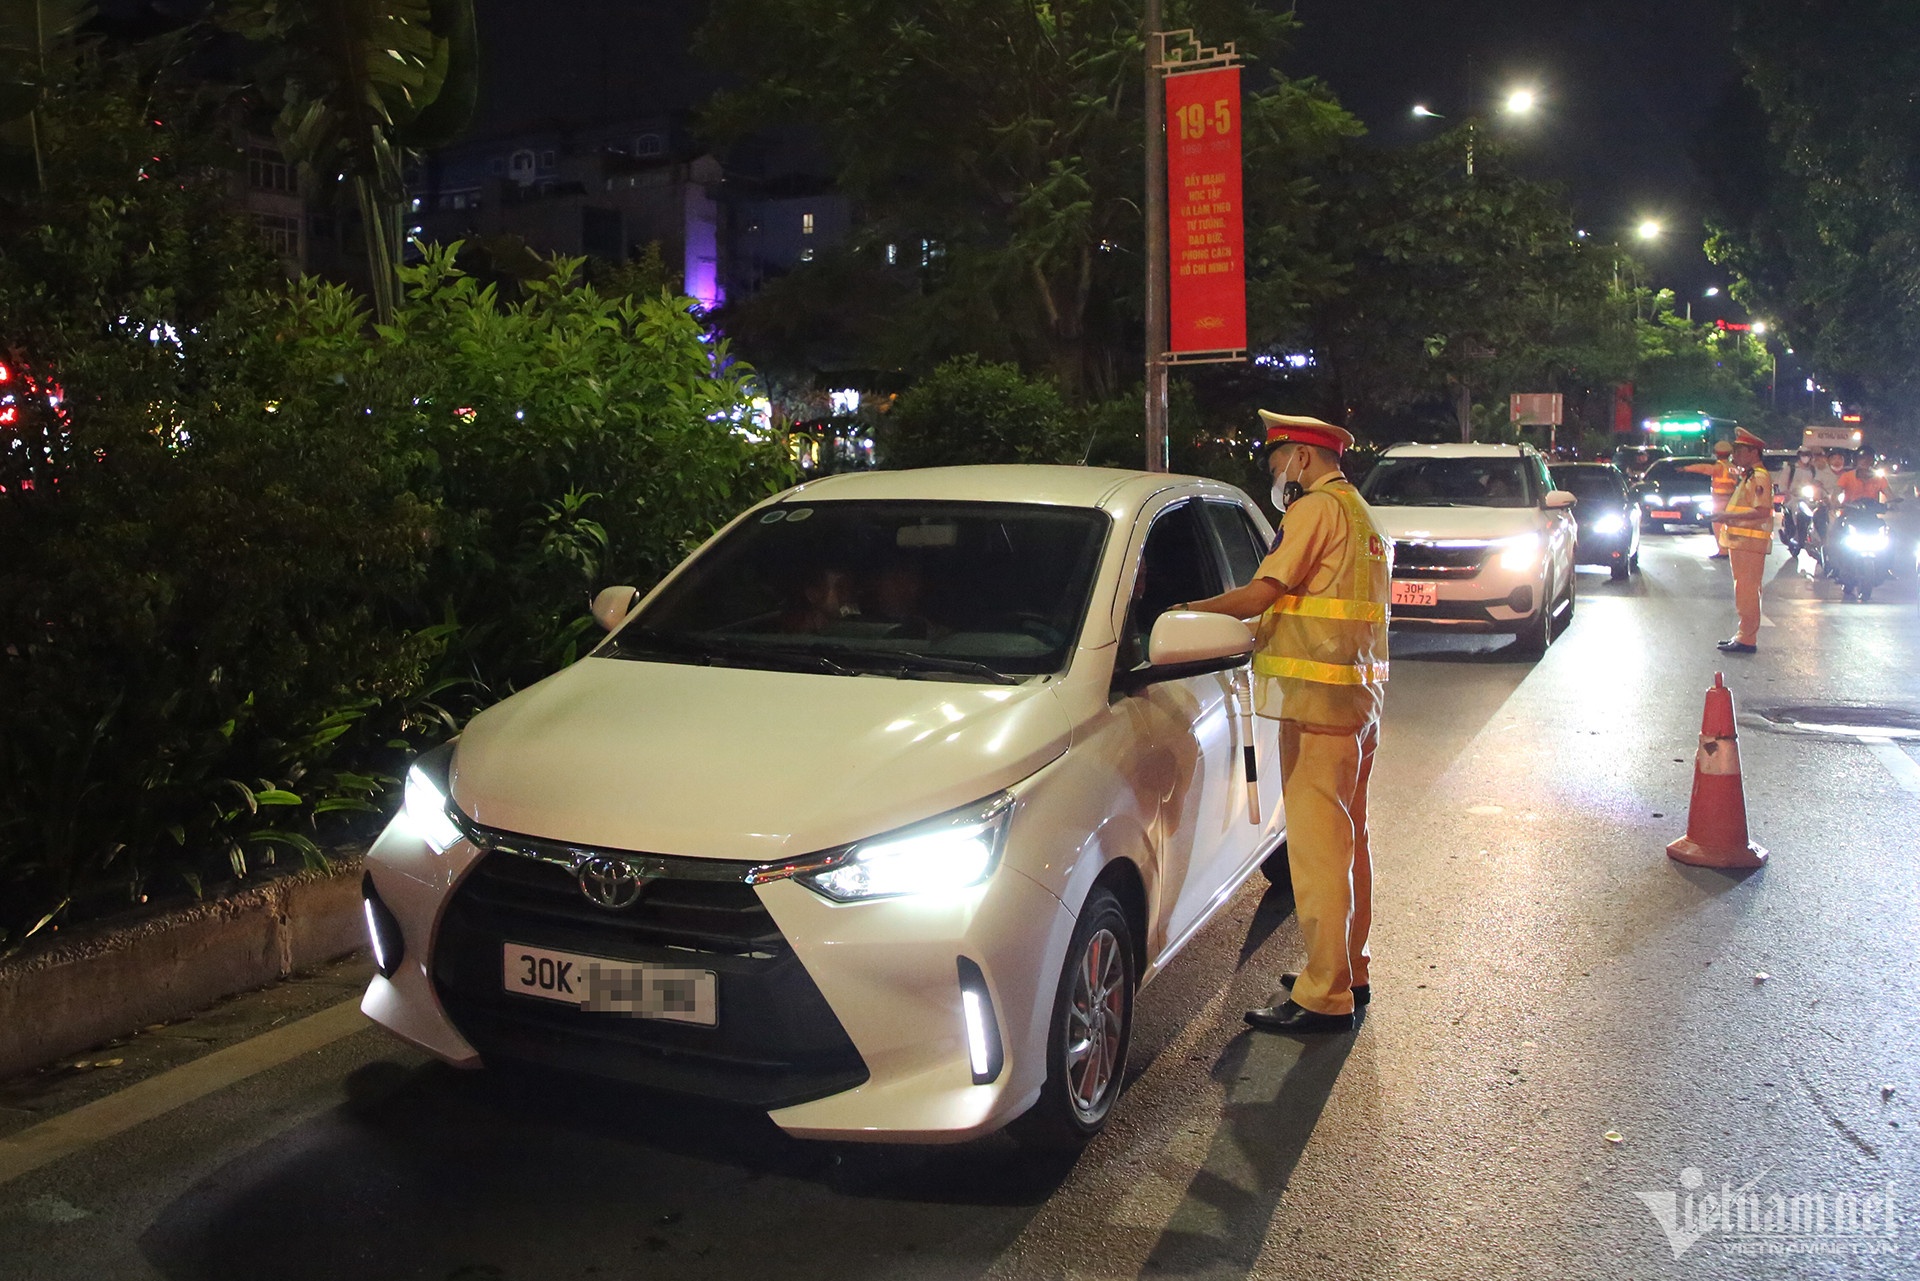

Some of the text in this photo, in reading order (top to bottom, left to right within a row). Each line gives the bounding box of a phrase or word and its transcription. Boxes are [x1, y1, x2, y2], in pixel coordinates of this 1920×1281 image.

[1213, 201, 1231, 214] THEO
[1404, 583, 1424, 594] 30H
[1396, 593, 1432, 604] 717.72
